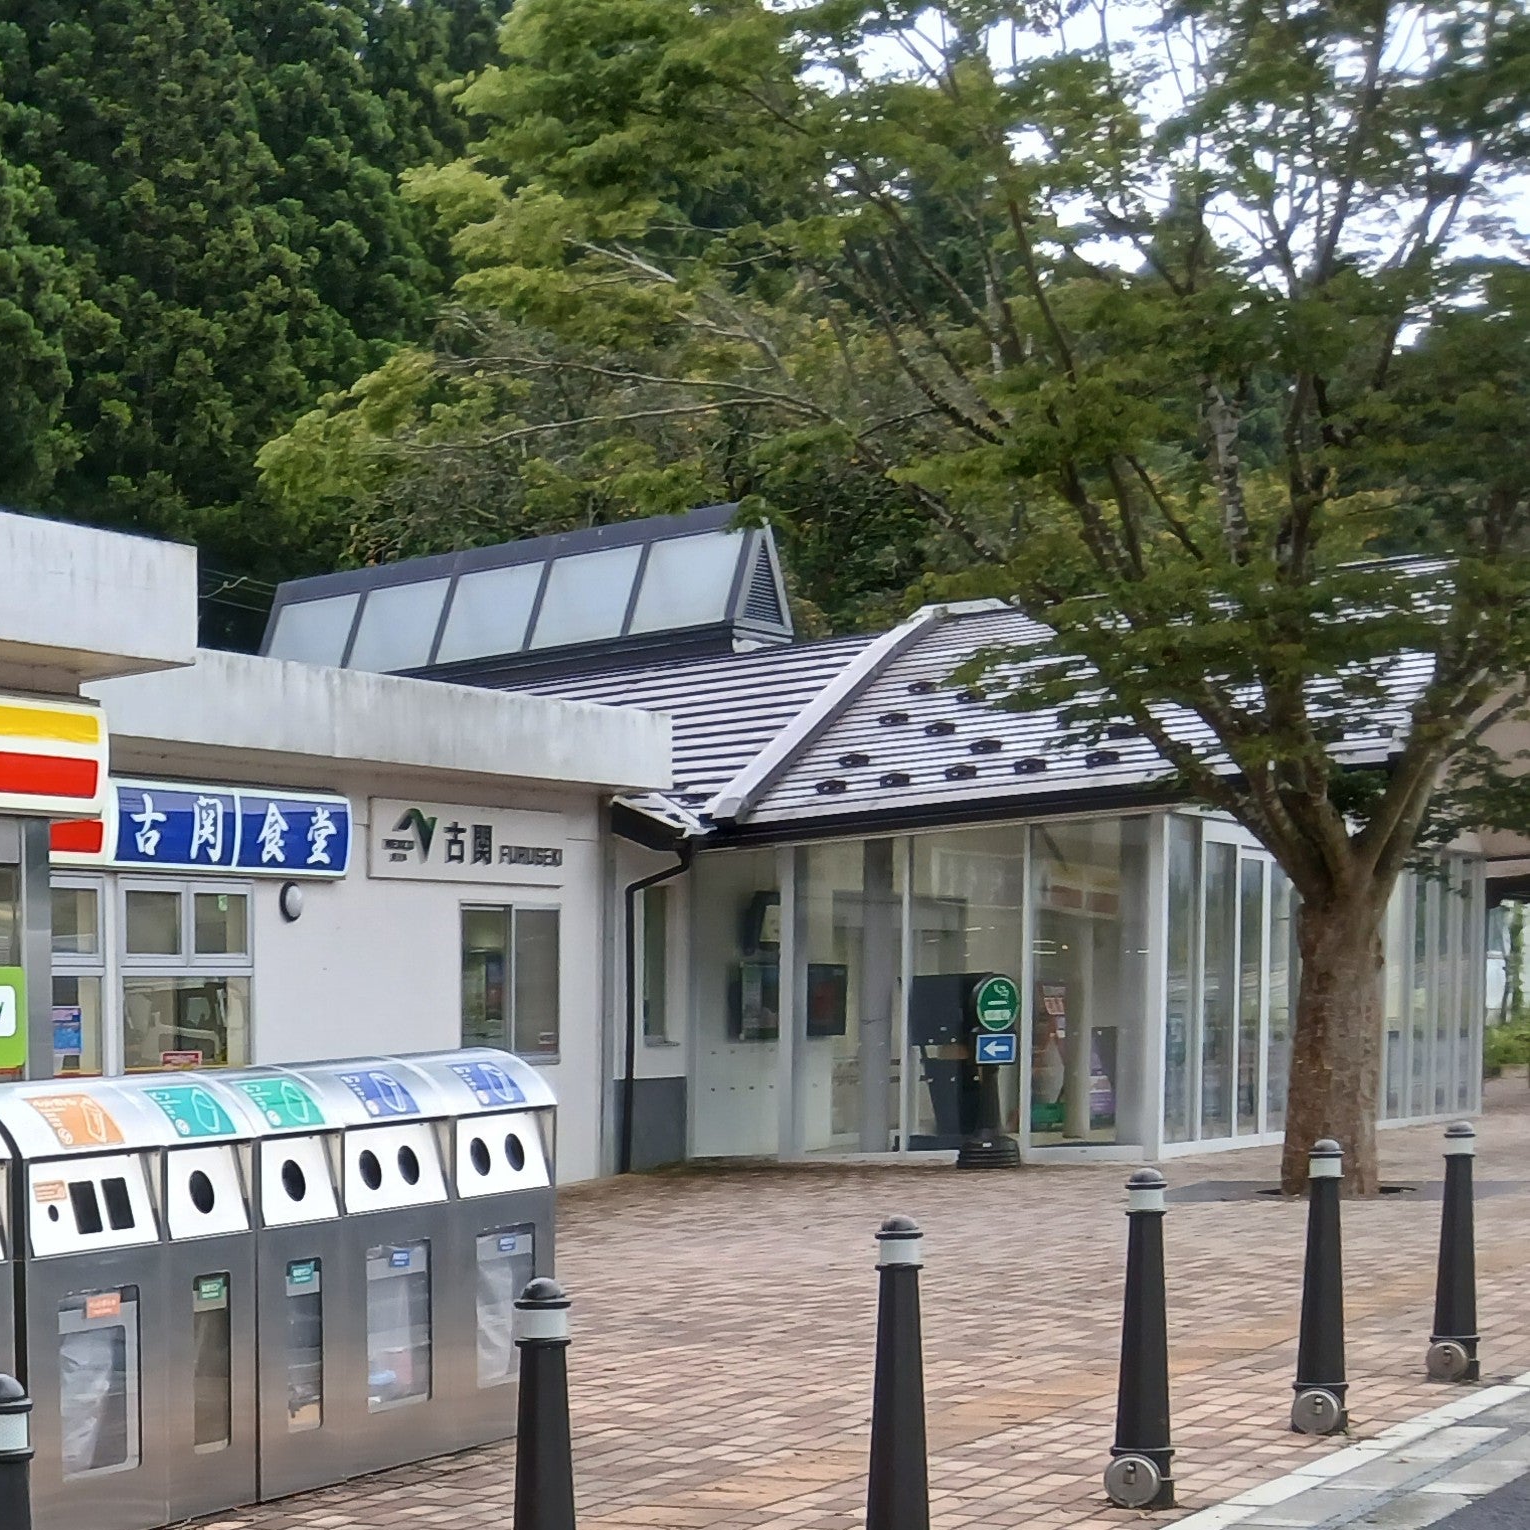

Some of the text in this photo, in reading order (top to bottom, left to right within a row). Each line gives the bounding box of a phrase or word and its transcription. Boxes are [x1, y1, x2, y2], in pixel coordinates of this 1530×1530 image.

[130, 793, 338, 864] 古関食堂
[443, 822, 493, 865] 古関
